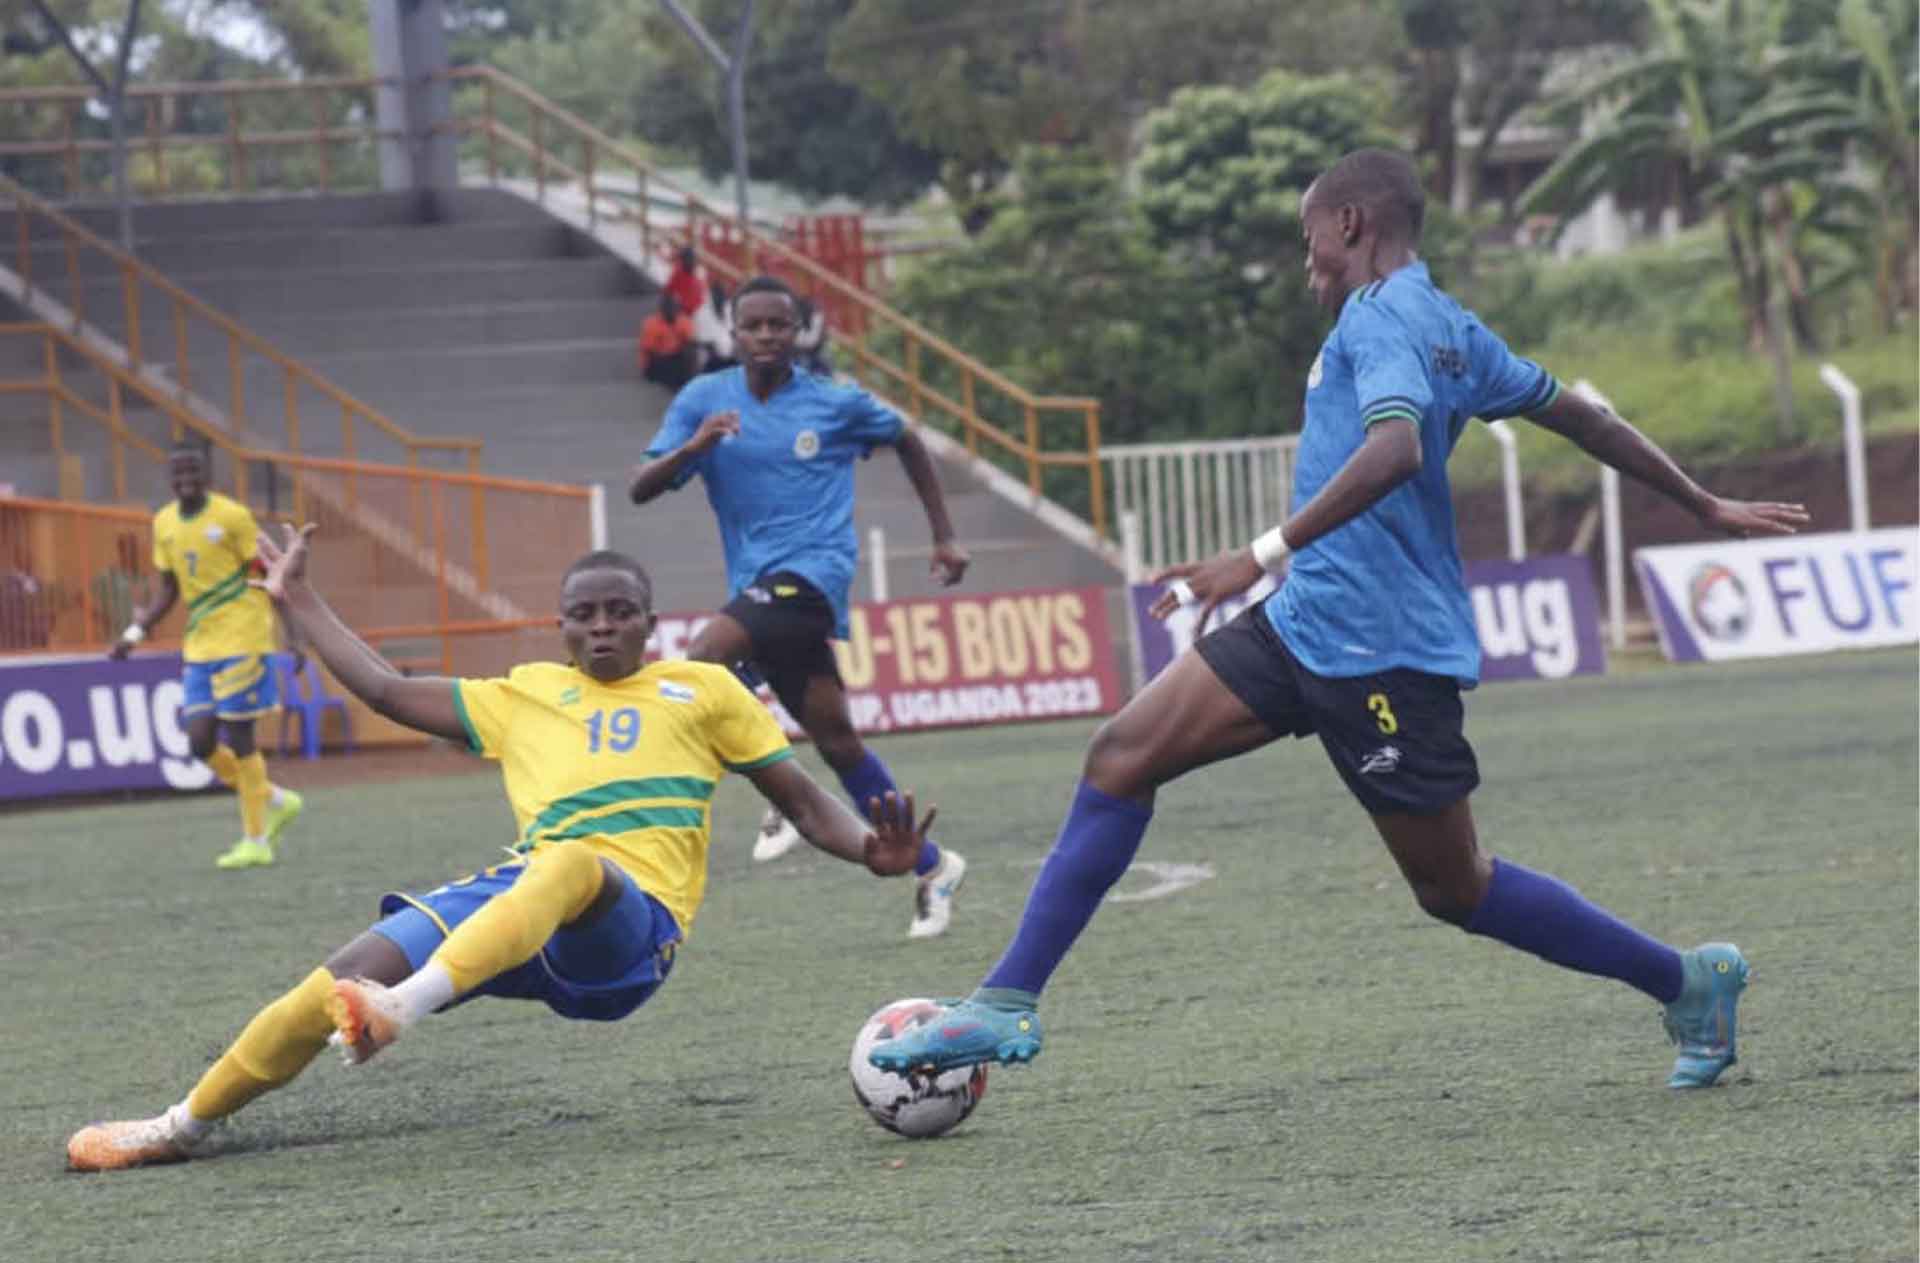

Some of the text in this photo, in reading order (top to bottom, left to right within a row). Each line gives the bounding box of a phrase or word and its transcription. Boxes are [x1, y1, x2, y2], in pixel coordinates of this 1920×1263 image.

[1762, 549, 1912, 638] FUF
[952, 593, 1093, 680] BOYS
[1471, 578, 1579, 678] ug
[585, 707, 642, 754] 19
[889, 682, 1023, 725] UGANDA
[1023, 676, 1101, 715] 2023
[1367, 692, 1398, 735] 3
